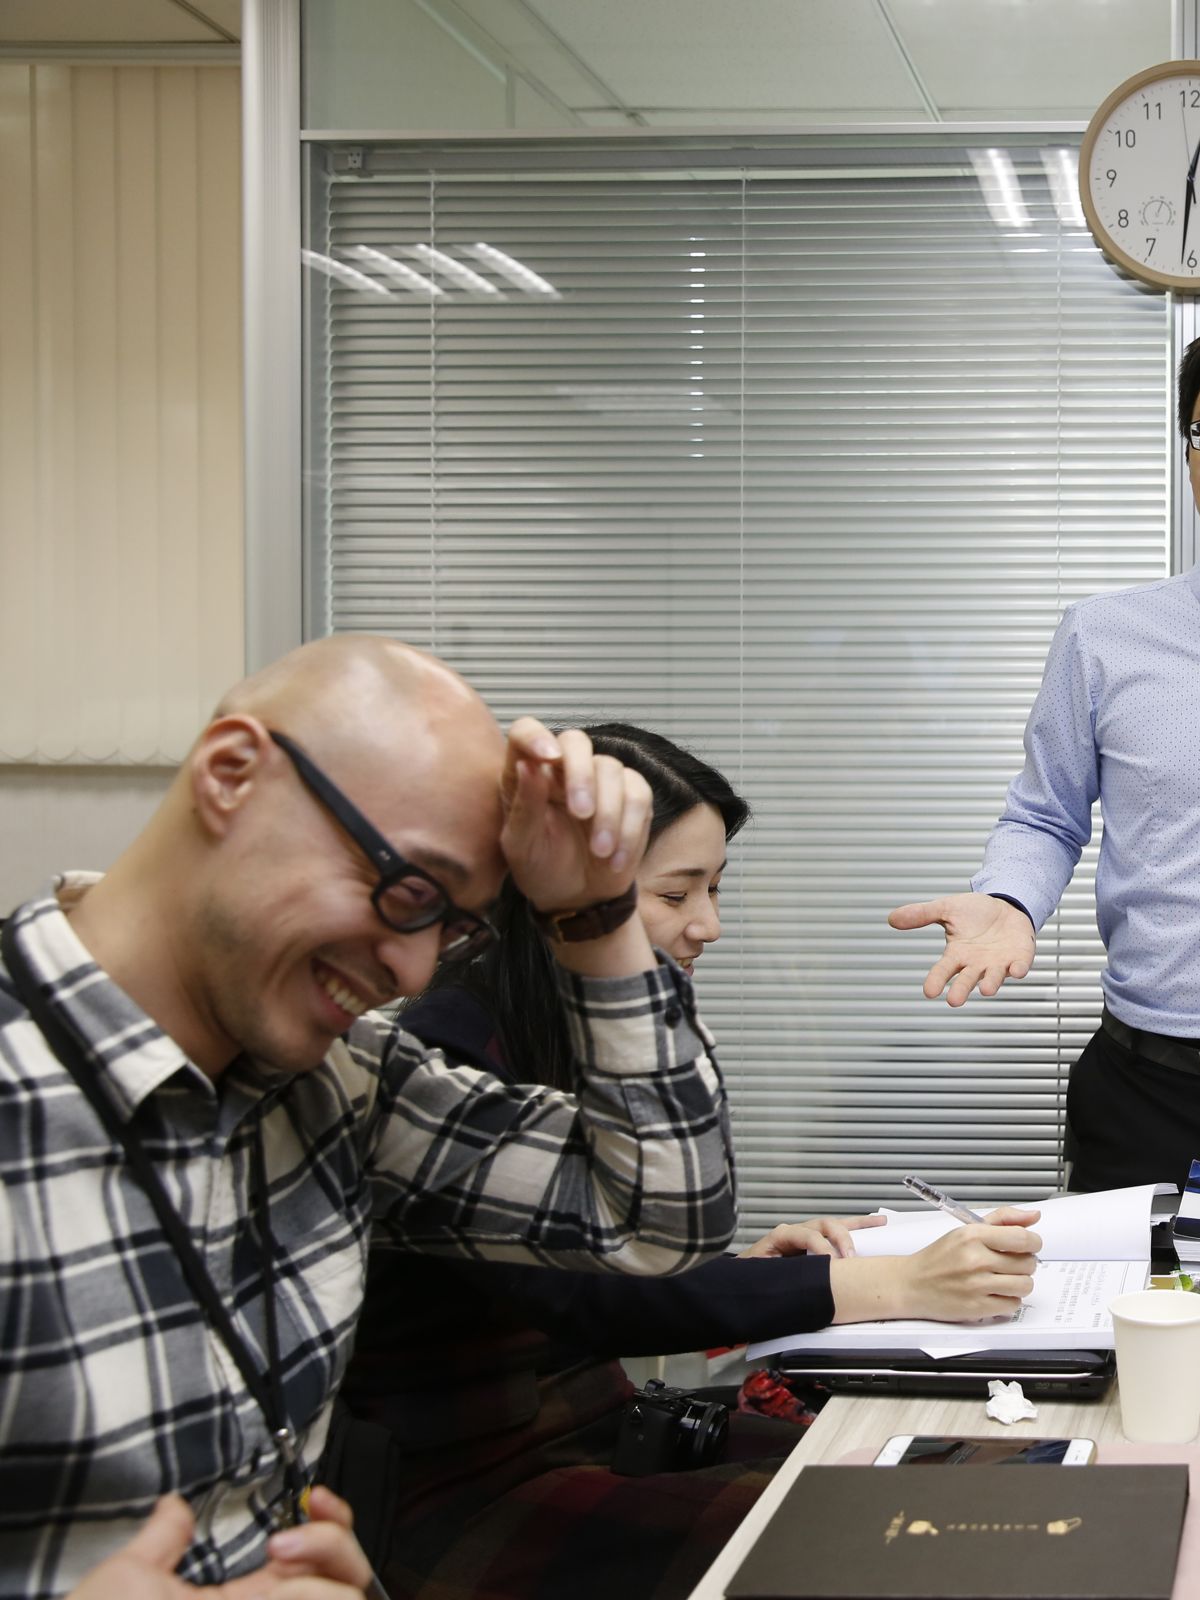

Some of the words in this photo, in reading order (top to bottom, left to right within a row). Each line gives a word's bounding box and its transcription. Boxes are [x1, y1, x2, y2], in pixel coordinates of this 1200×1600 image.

[1180, 91, 1200, 107] 12
[1144, 103, 1162, 120] 11
[1115, 130, 1136, 147] 10
[1107, 170, 1116, 187] 9
[1119, 210, 1128, 227] 8
[1146, 238, 1156, 256] 7
[1187, 250, 1197, 267] 6
